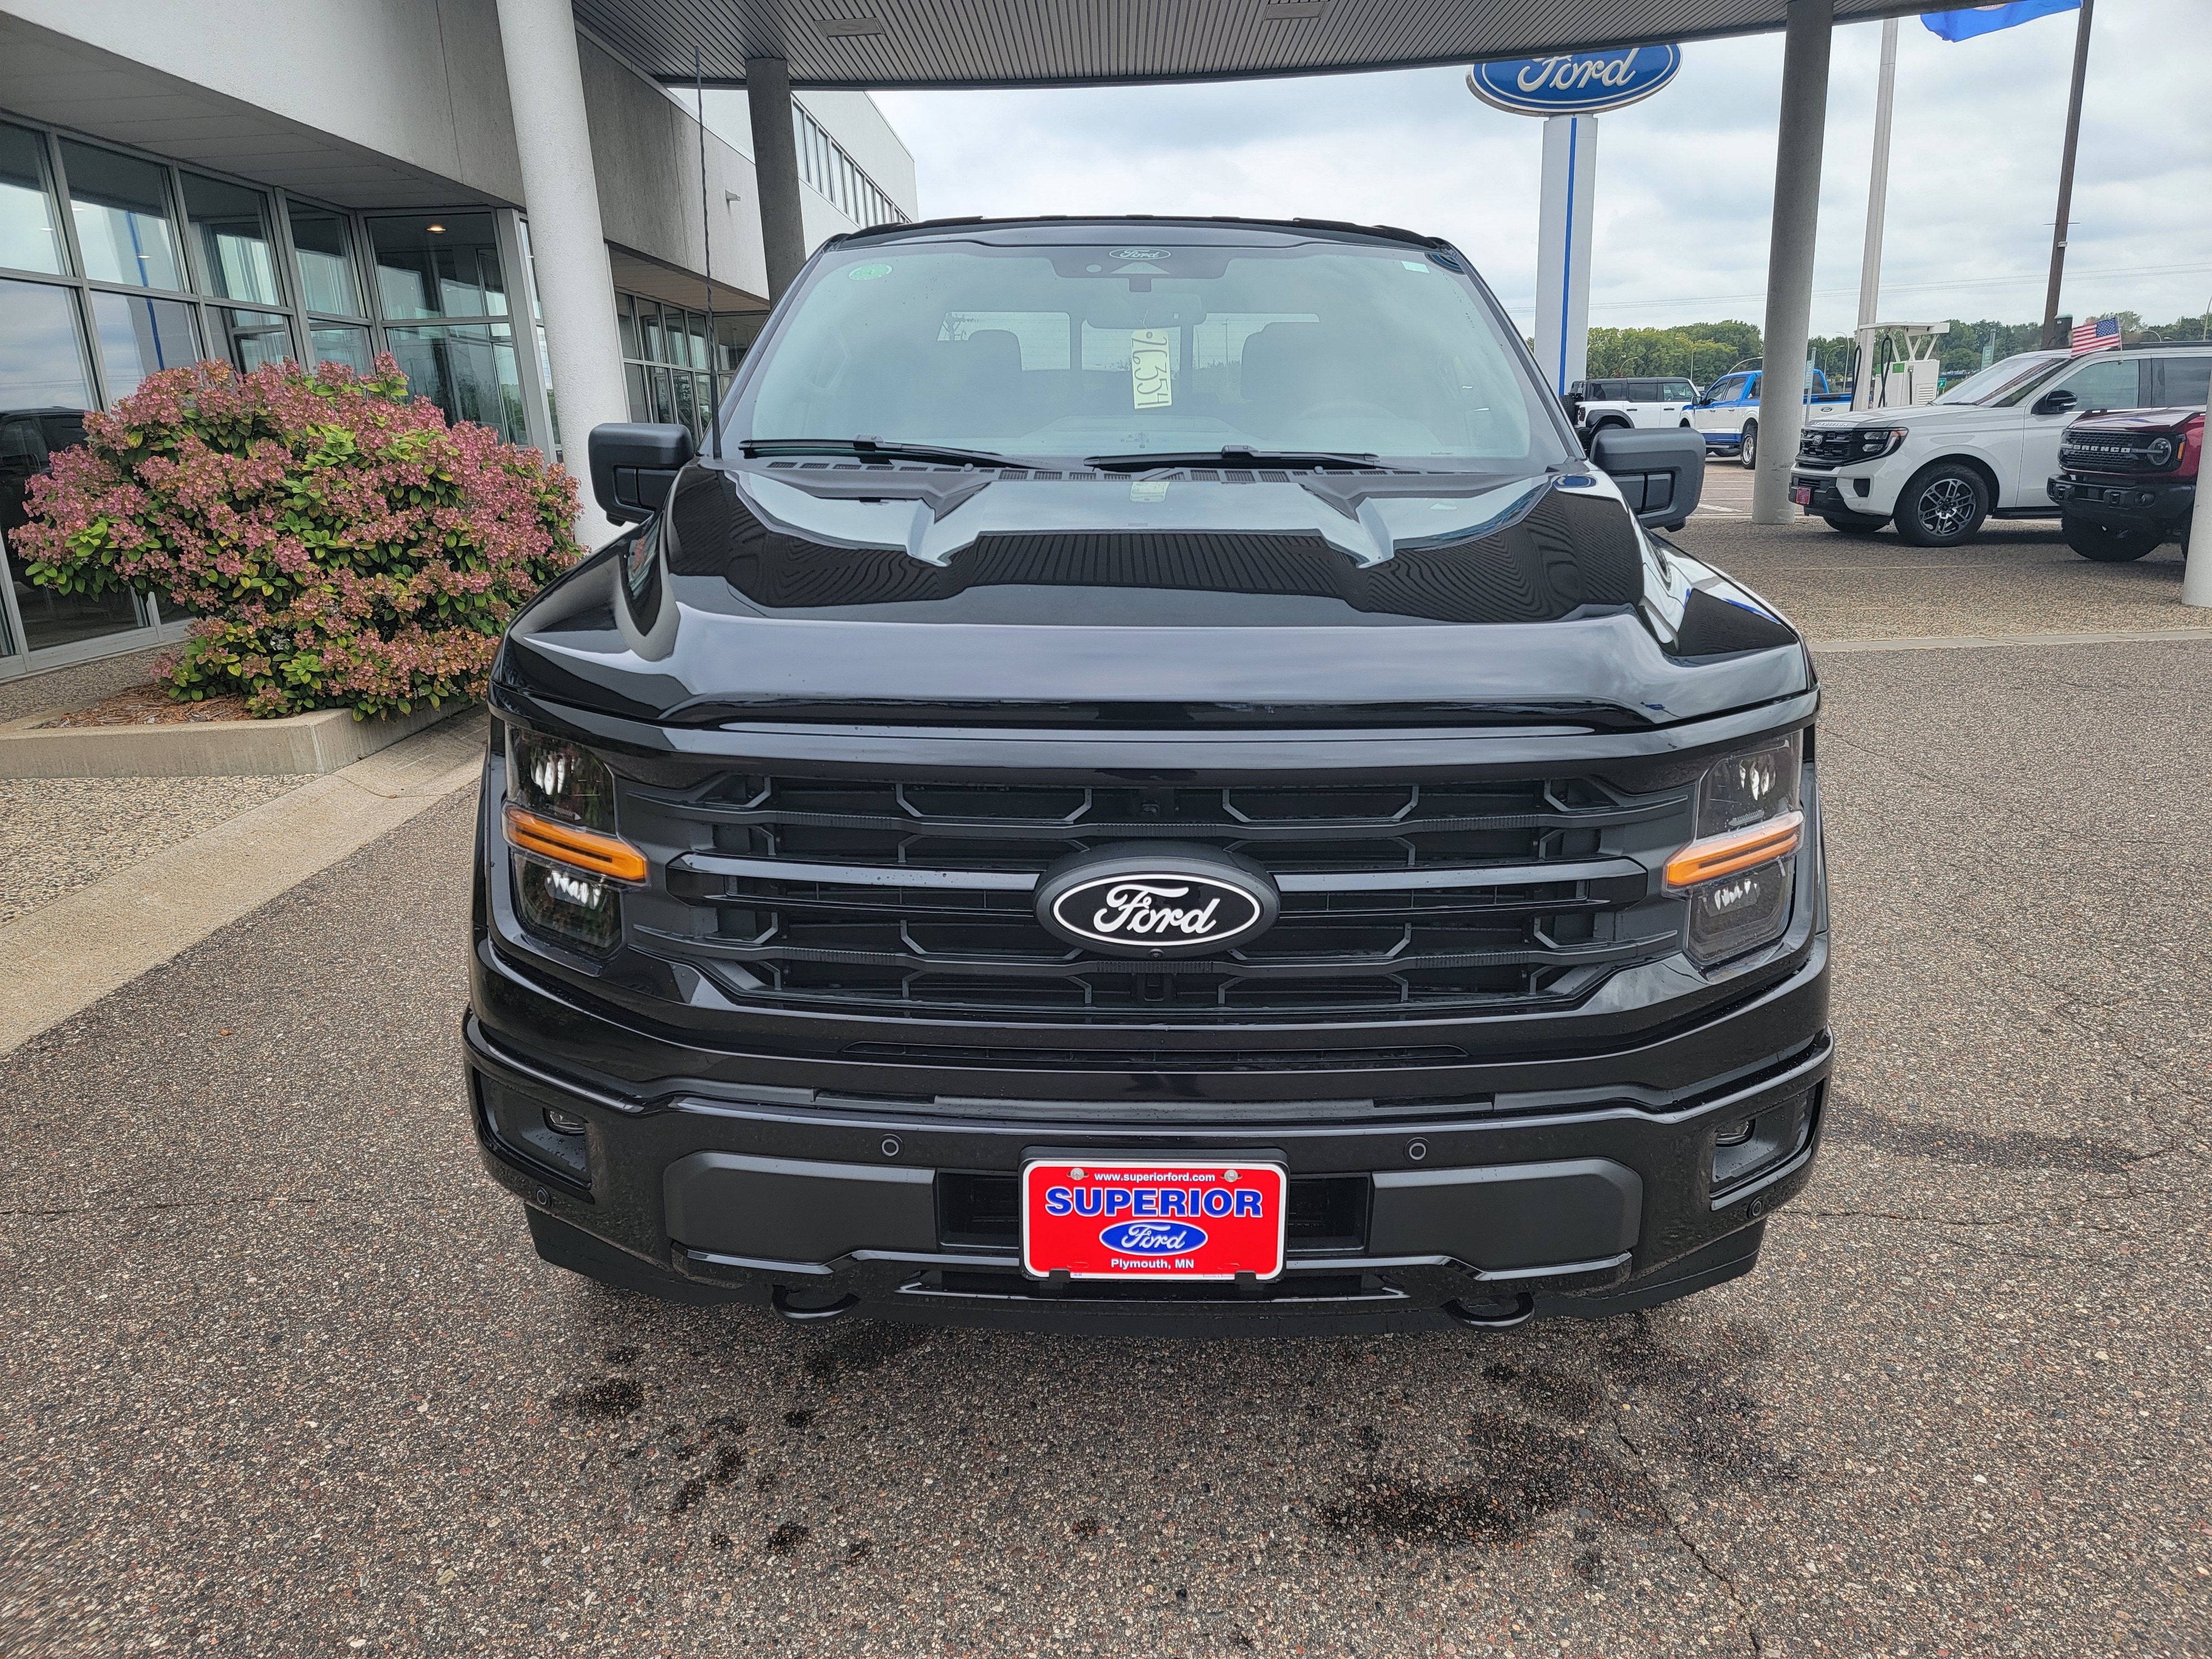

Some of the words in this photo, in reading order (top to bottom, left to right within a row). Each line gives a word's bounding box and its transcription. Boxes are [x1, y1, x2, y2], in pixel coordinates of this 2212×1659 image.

[1517, 48, 1640, 92] Ford
[1120, 249, 1160, 258] Ford
[1131, 336, 1169, 406] 26354
[2073, 445, 2131, 453] BRONCO
[1093, 884, 1220, 933] Ford
[1094, 1172, 1215, 1183] www.superiorford.com
[1045, 1186, 1263, 1218] SUPERIOR
[1121, 1224, 1187, 1250] Ford
[1110, 1258, 1171, 1270] Plymouth,
[1175, 1259, 1194, 1269] MN
